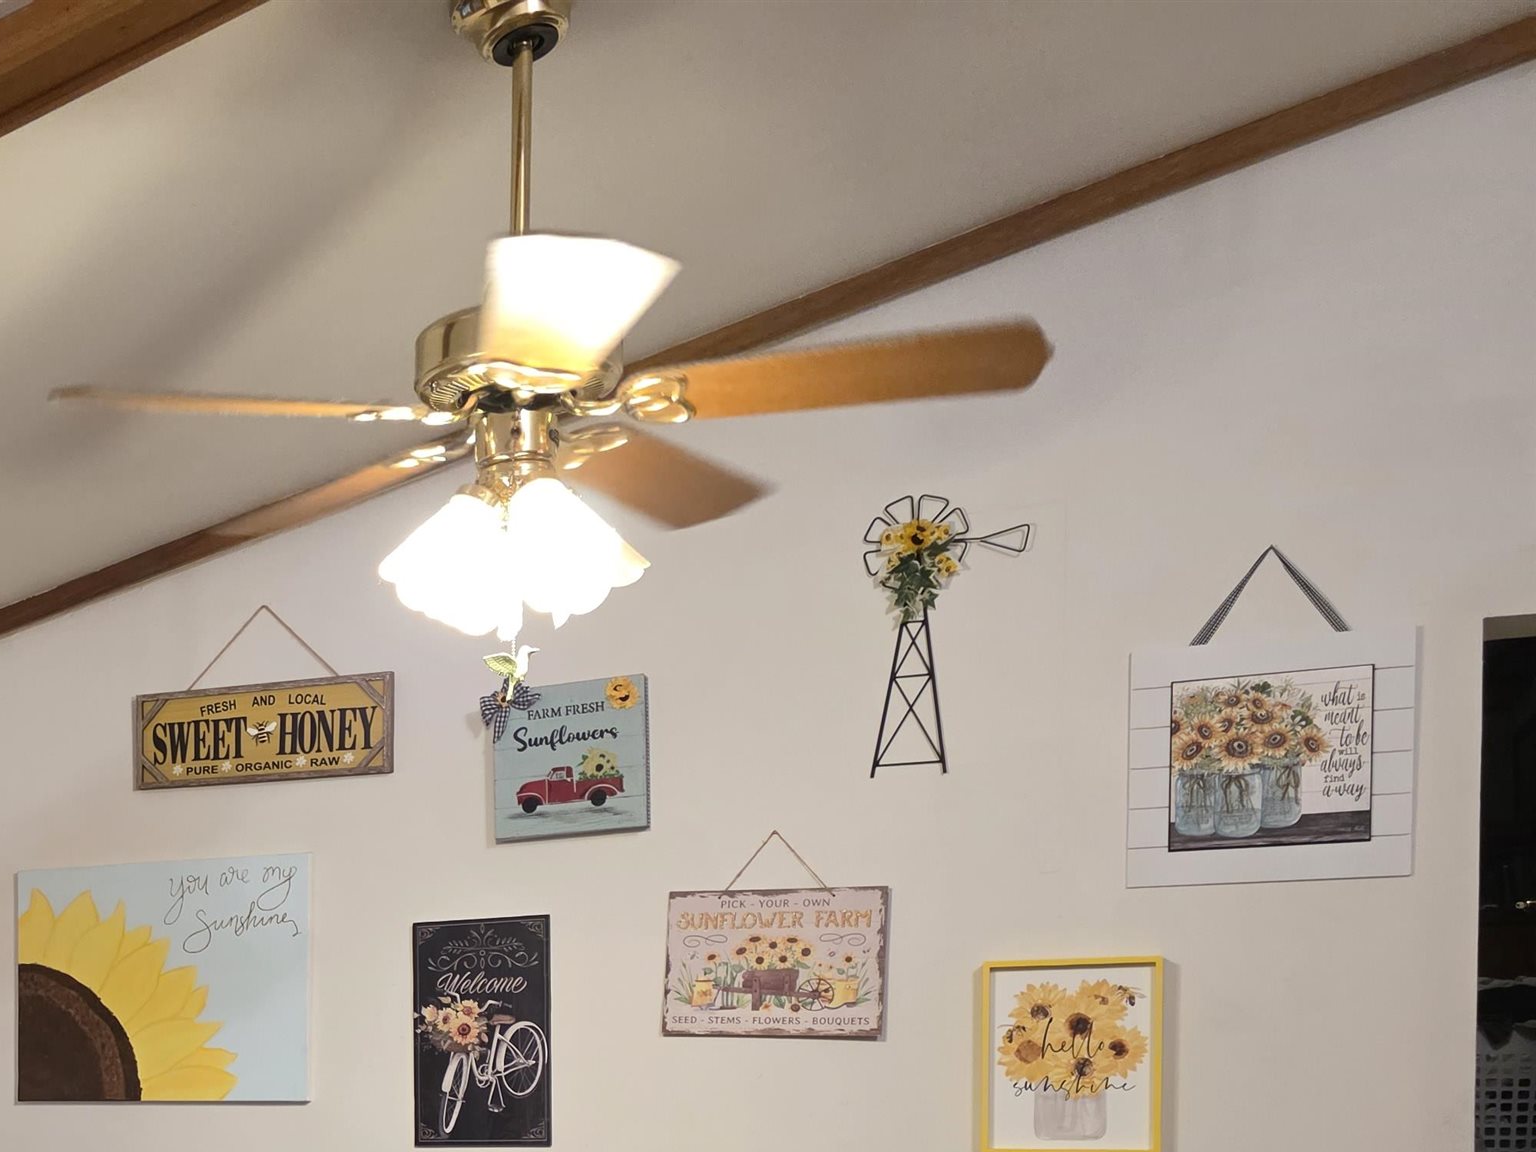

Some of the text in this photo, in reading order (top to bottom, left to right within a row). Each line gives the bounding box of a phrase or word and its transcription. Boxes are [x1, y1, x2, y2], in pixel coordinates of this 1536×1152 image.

[200, 693, 327, 717] FRESH AND LOCAL
[1321, 681, 1358, 707] what
[527, 701, 605, 721] FARM FRESH
[1324, 705, 1361, 726] meant
[152, 705, 379, 766] SWEET HONEY
[513, 725, 619, 752] Sunflowers
[1320, 748, 1364, 778] always
[1338, 747, 1358, 755] will
[186, 756, 340, 776] PURE ORGANIC RAW
[1324, 774, 1345, 783] find
[219, 866, 251, 888] are
[256, 865, 297, 911] my
[720, 898, 831, 909] PICK YOUR OWN
[676, 908, 873, 931] SUNFLOWER FARM
[436, 971, 528, 995] Welcome
[672, 1015, 870, 1027] SEED STEMS FLOWERS BOUQUETS
[1041, 1017, 1105, 1060] hello
[1012, 1076, 1137, 1101] sunshine
